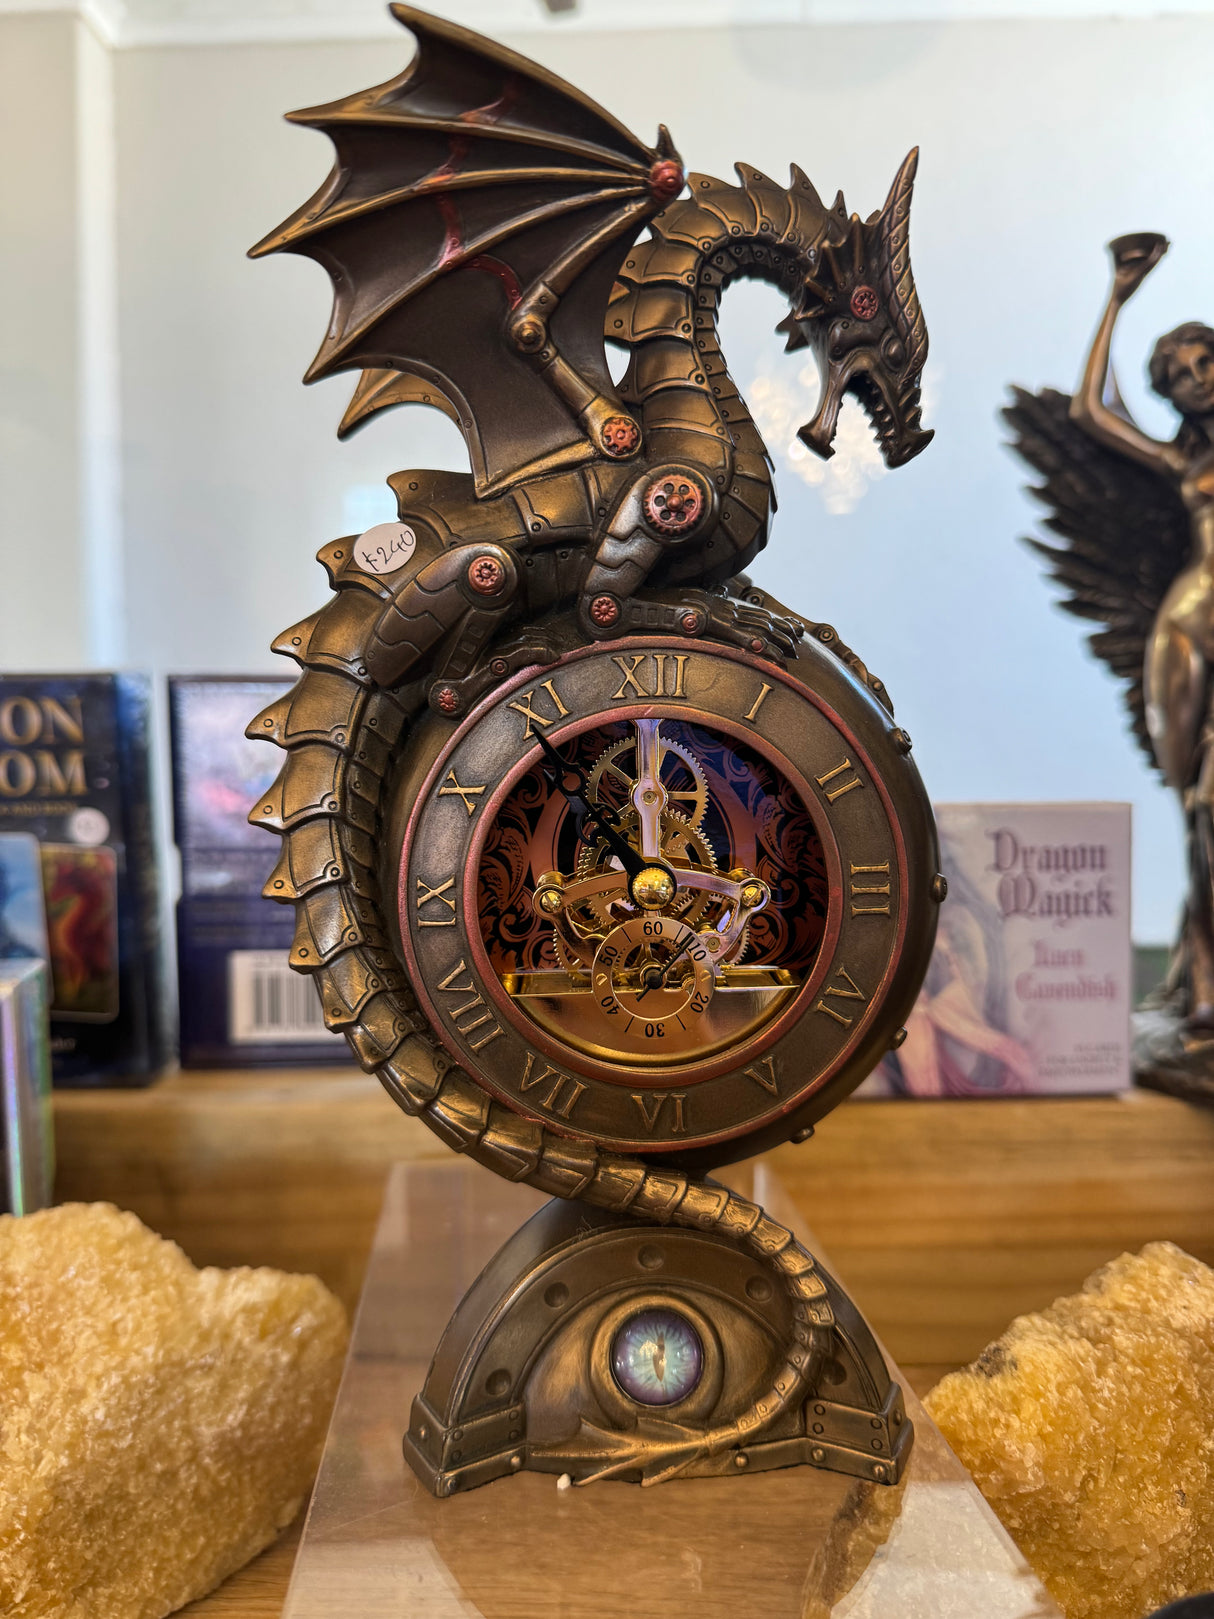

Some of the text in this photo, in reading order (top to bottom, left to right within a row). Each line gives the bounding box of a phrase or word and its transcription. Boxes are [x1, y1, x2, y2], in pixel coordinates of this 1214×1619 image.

[611, 655, 690, 700] XII
[509, 679, 570, 742] XI
[743, 682, 774, 722] I
[438, 769, 489, 817] X
[814, 757, 866, 804] II
[985, 827, 1107, 884] Dragon
[416, 875, 457, 928] IX
[849, 861, 892, 918] III
[998, 870, 1115, 930] Magick
[642, 920, 663, 936] 60
[598, 945, 618, 967] 50
[687, 942, 707, 962] 10
[437, 960, 508, 1057] VIII
[600, 995, 620, 1016] 40
[690, 991, 709, 1013] 20
[815, 966, 872, 1029] IV
[644, 1022, 665, 1038] 30
[519, 1051, 590, 1120] VII
[743, 1054, 782, 1097] V
[631, 1093, 689, 1134] VI
